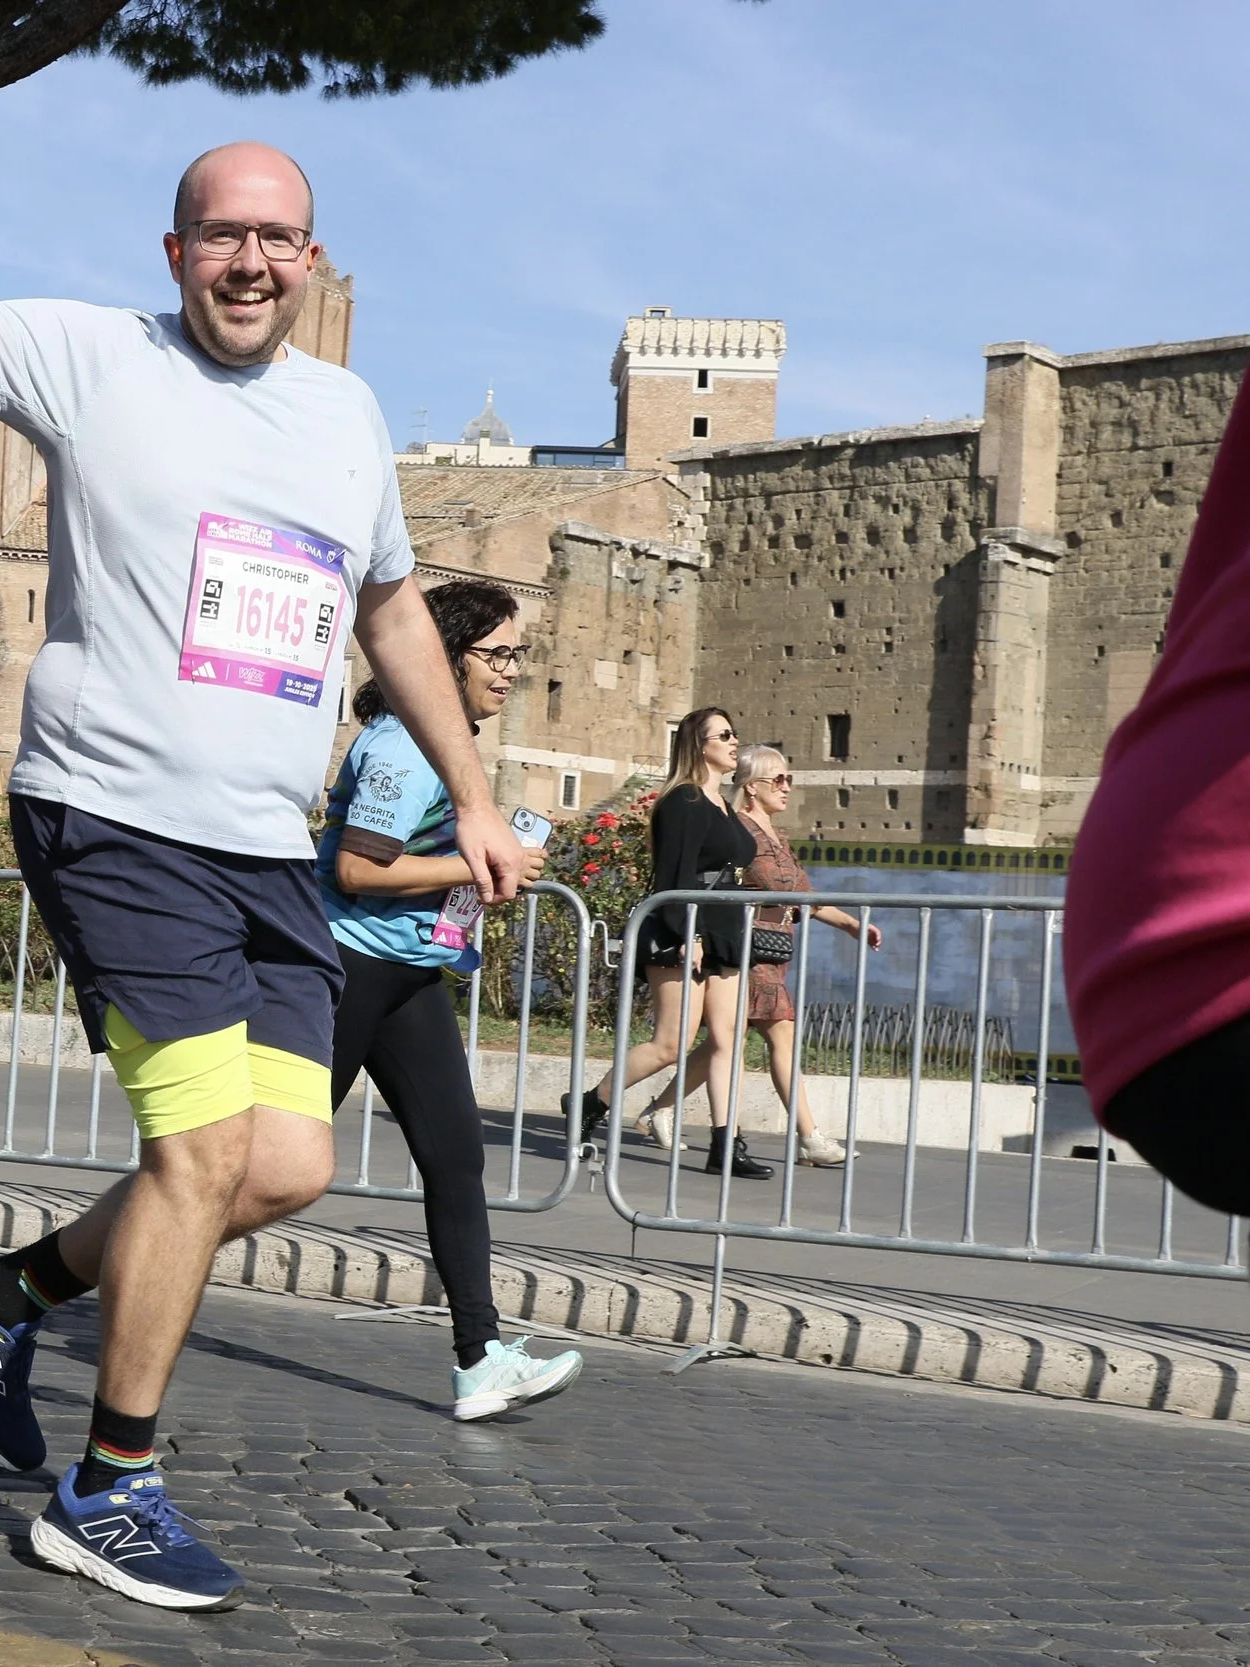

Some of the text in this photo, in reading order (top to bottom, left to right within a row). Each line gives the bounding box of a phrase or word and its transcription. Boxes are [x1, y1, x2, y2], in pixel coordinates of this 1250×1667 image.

[295, 540, 323, 560] ROMA
[242, 561, 310, 585] CHRISTOPHER
[236, 585, 309, 647] 16145
[359, 803, 396, 821] NEGRITA
[363, 813, 393, 829] CAFÉS
